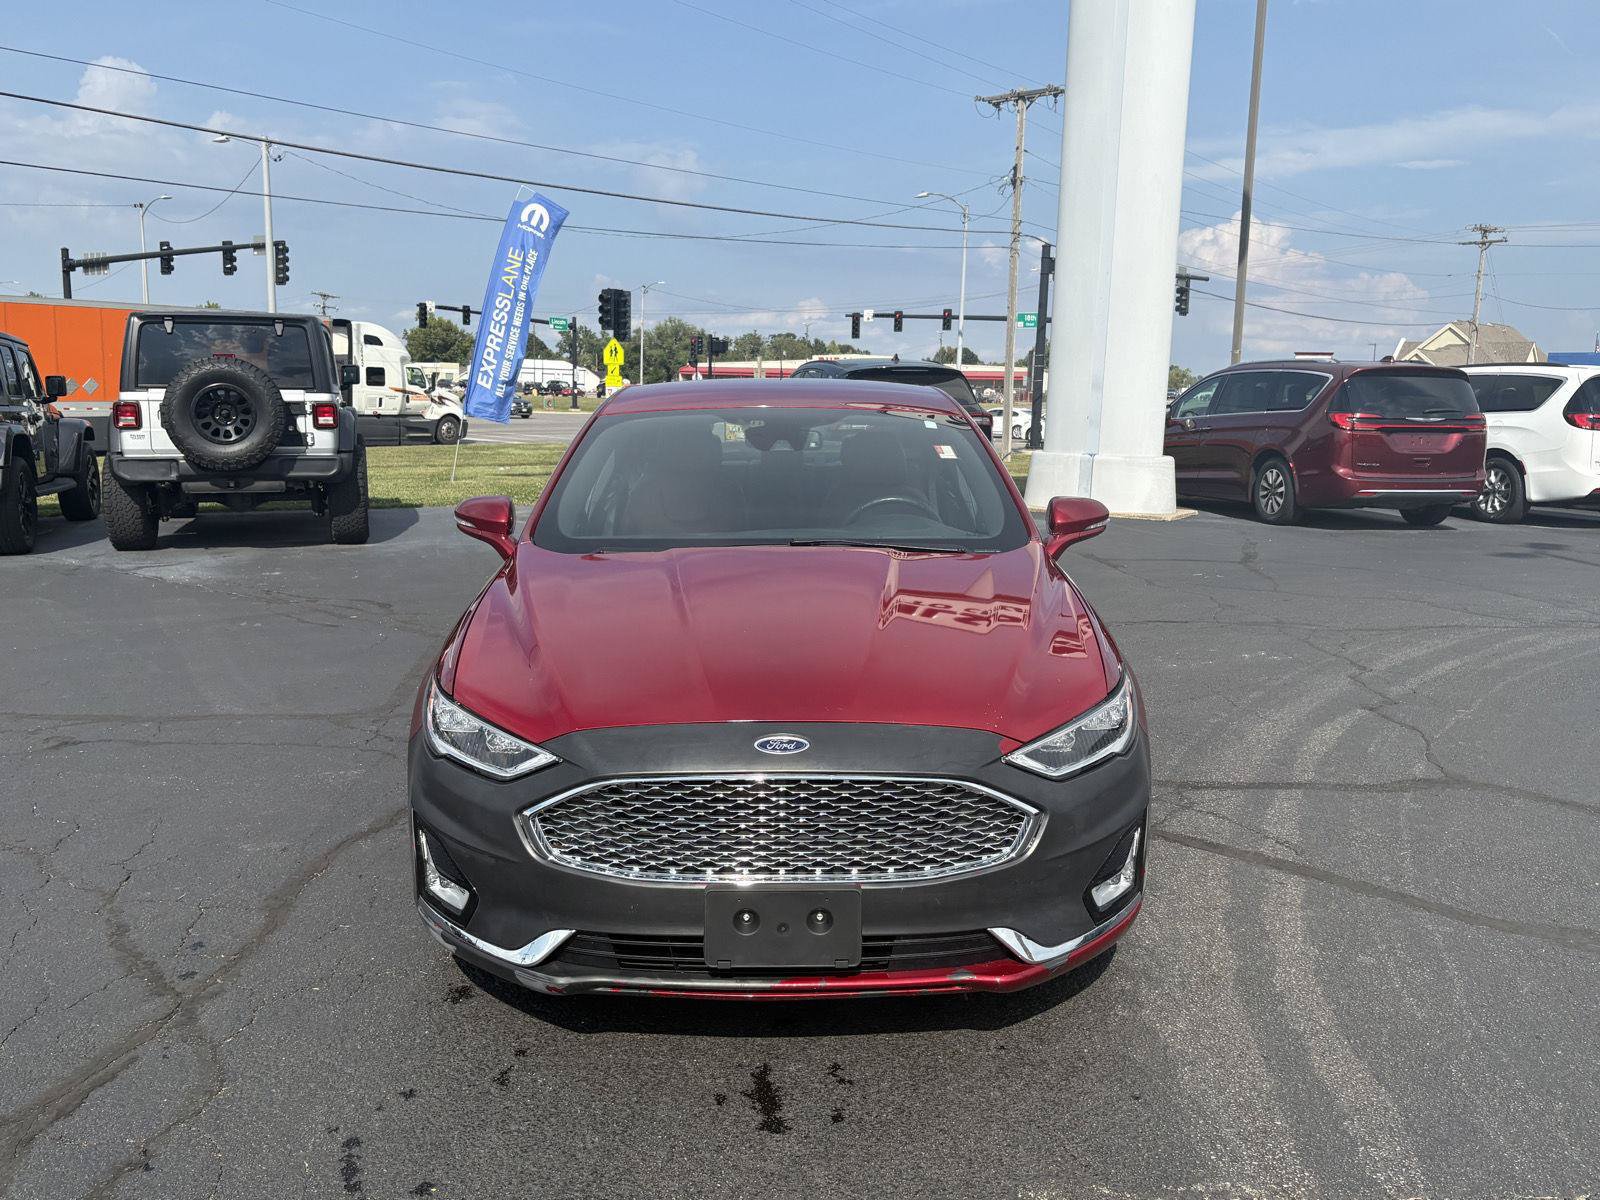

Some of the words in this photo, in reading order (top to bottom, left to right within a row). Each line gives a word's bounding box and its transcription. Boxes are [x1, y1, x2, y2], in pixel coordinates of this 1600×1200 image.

[524, 248, 539, 275] PLACE
[521, 275, 530, 291] ONE
[518, 292, 527, 301] IN
[512, 301, 525, 327] NEEDS
[505, 326, 521, 360] SERVICE
[499, 360, 512, 381] YOUR
[495, 383, 506, 398] ALL
[766, 739, 796, 750] Ford
